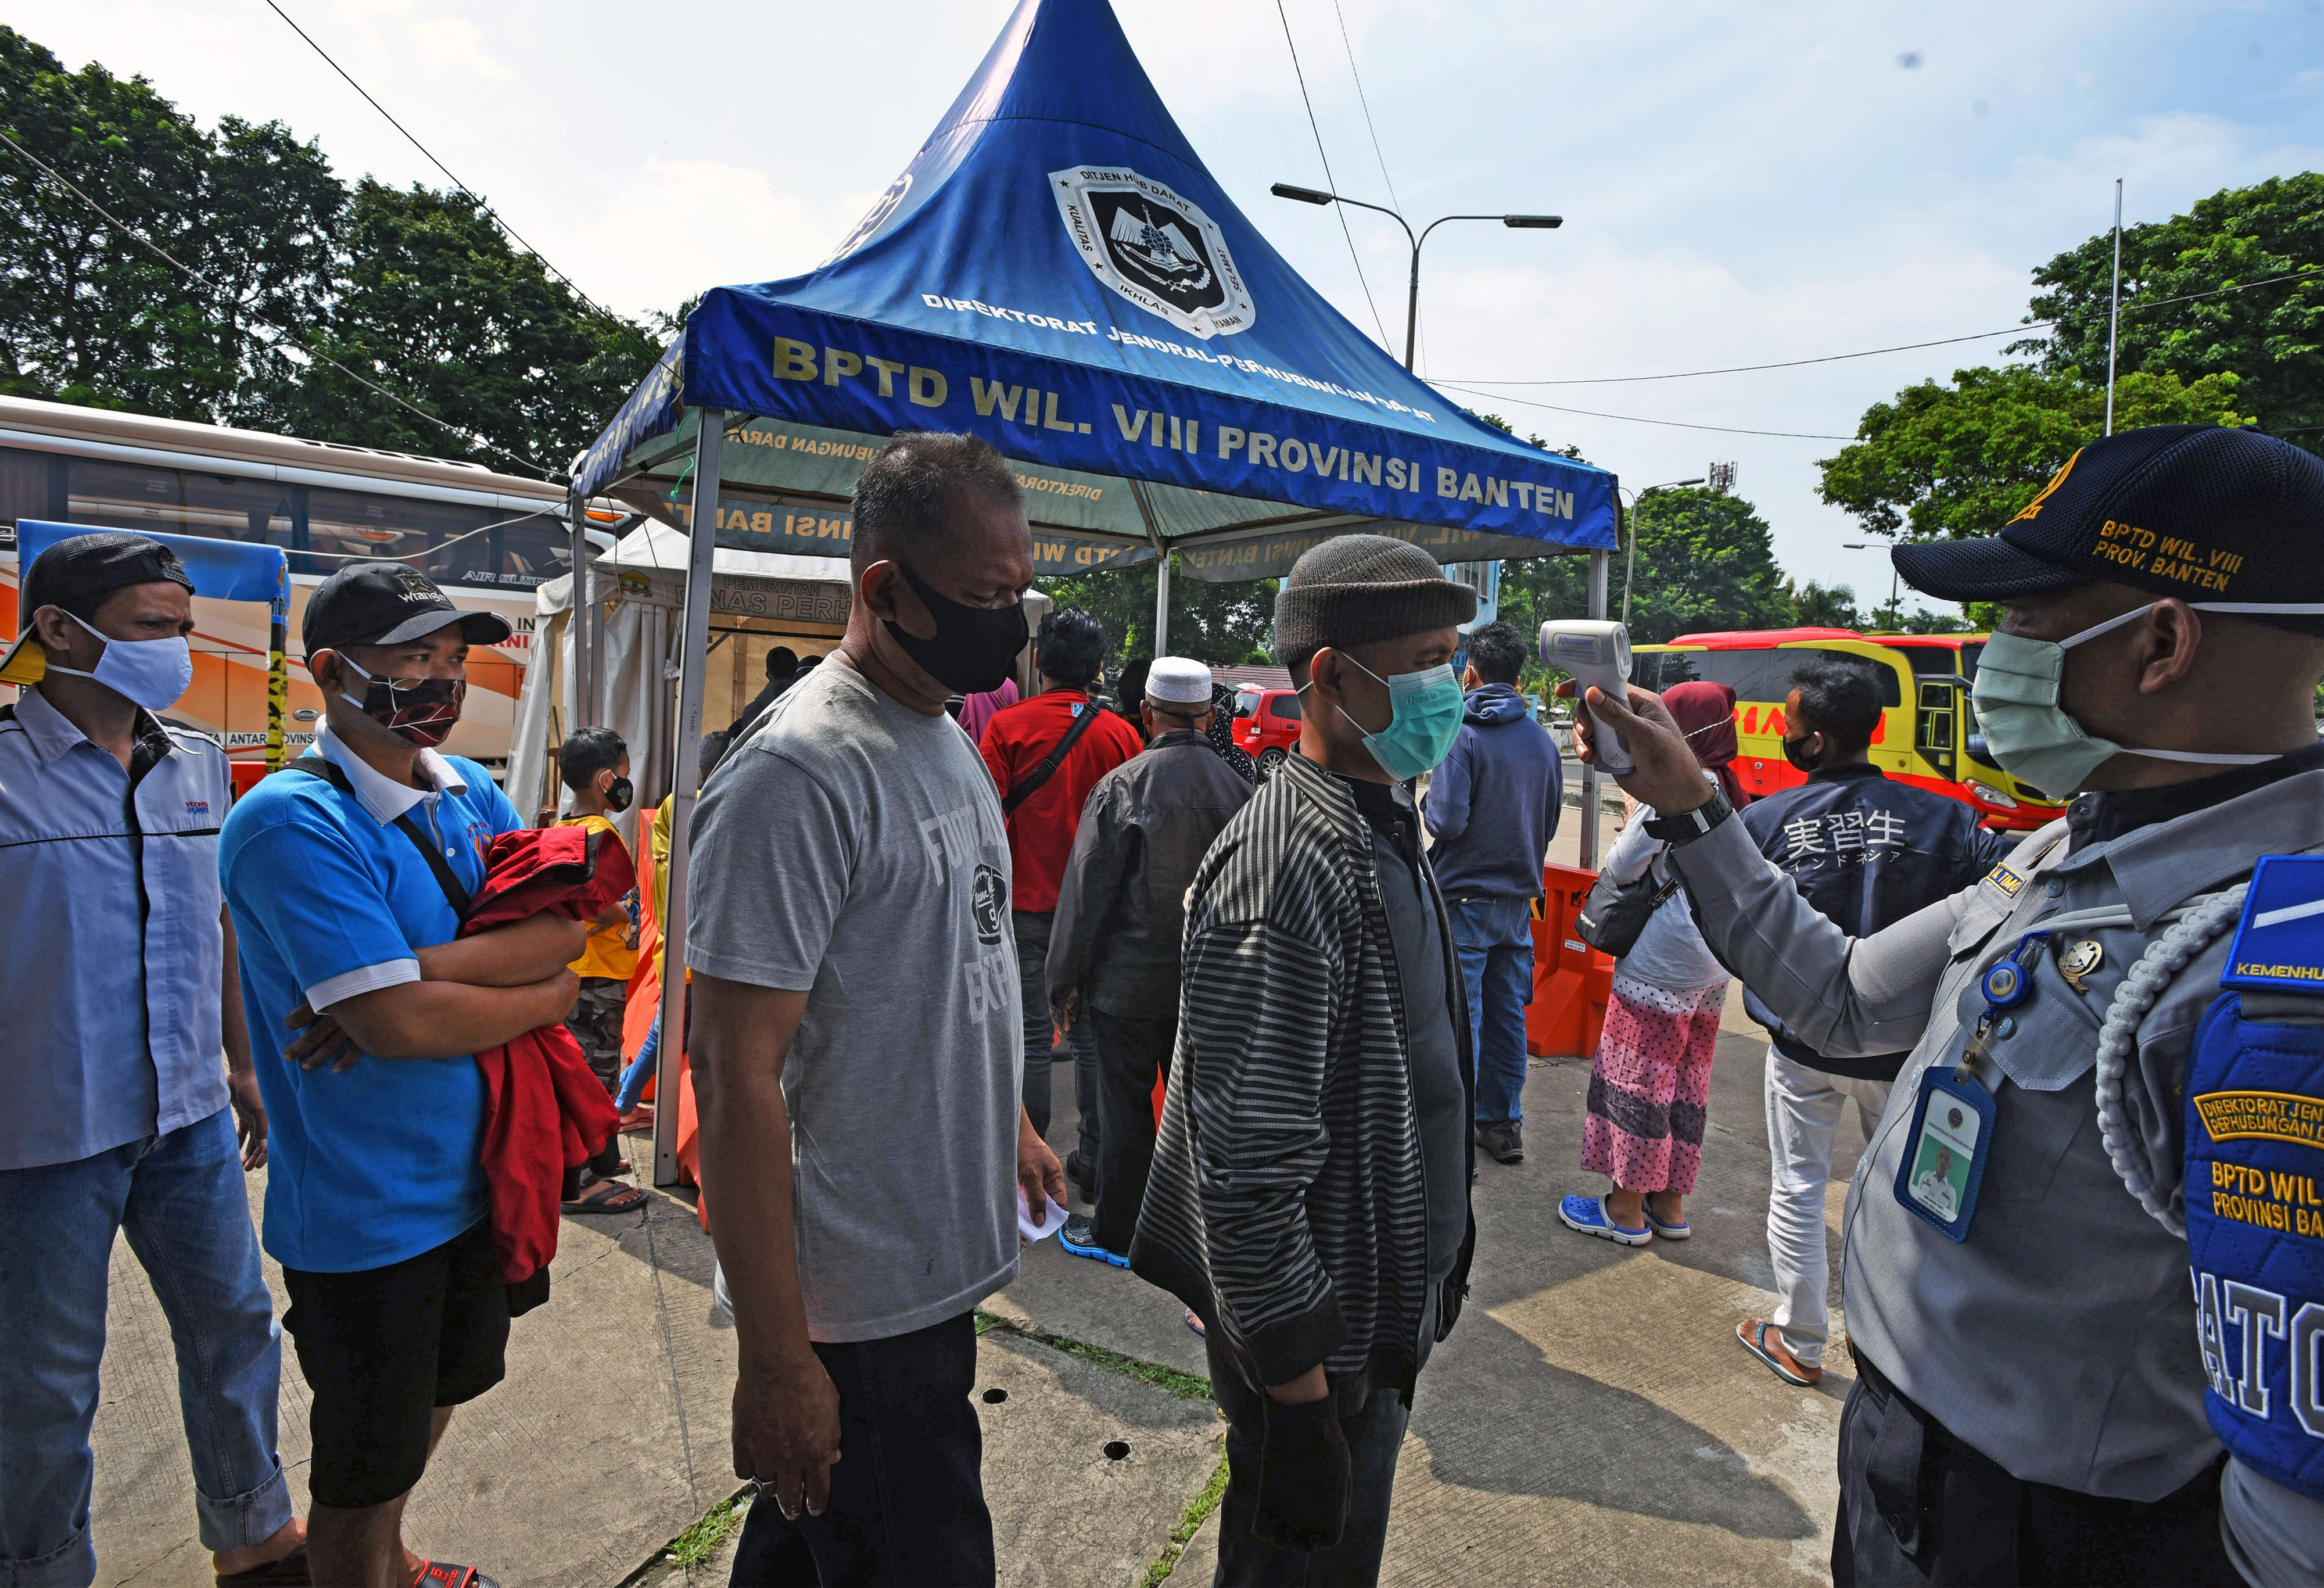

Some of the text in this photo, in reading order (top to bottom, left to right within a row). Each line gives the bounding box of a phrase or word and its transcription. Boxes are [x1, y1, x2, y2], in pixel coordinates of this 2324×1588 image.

[1079, 171, 1190, 212] DITJEN HUB DARAT
[1067, 204, 1092, 252] KUALITAS
[1217, 247, 1242, 293] SELAMAT
[1120, 284, 1168, 316] IKHLAS
[921, 293, 1098, 335] DIREKTORAT
[1107, 325, 1217, 364] JENDRAL
[772, 336, 1574, 520] BPTD WIL. VIII PROVINSI BANTEN
[2100, 519, 2244, 573] BPTD WIL. VIII
[461, 571, 496, 582] AIR
[2093, 540, 2230, 593] PROV. BANTEN
[725, 576, 820, 597] PEMERINTAH
[229, 733, 267, 744] ANTAR
[1784, 809, 1906, 859] 実習生
[1789, 849, 1901, 872] インドネシア
[2236, 962, 2324, 981] KEMENHU
[2203, 1098, 2324, 1122] DIREKTORAT JEN
[2211, 1115, 2315, 1137] PERHUBUNGAN
[2212, 1162, 2267, 1196] BPTD
[2212, 1191, 2324, 1238] PROVINSI BA
